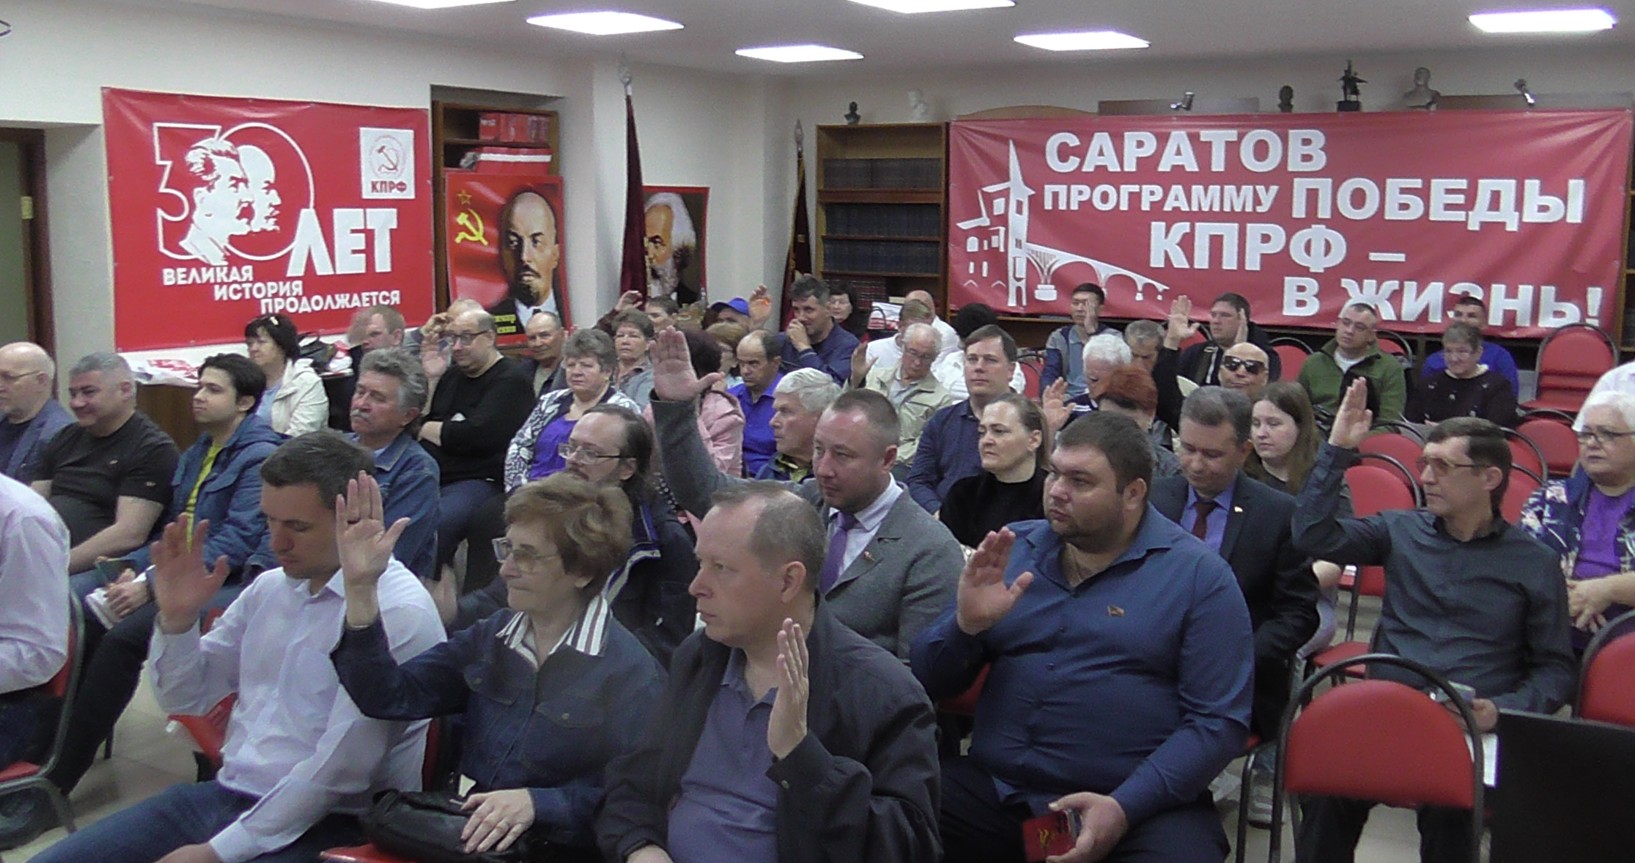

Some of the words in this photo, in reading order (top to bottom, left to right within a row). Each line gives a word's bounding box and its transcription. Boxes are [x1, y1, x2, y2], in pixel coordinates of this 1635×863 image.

[1045, 129, 1327, 173] САРАТОВ
[371, 181, 407, 194] КПРФ
[1043, 184, 1280, 213] ПРОГРАММУ
[1291, 177, 1586, 232] ПОБЕДЫ
[286, 207, 398, 278] ЛЕТ
[1150, 221, 1347, 273] КПРФ
[162, 265, 254, 286] ВЕЛИКАЯ
[213, 280, 304, 302] ИСТОРИЯ
[260, 289, 401, 315] ПРОДОЛЖАЕТСЯ
[1282, 276, 1321, 317] В
